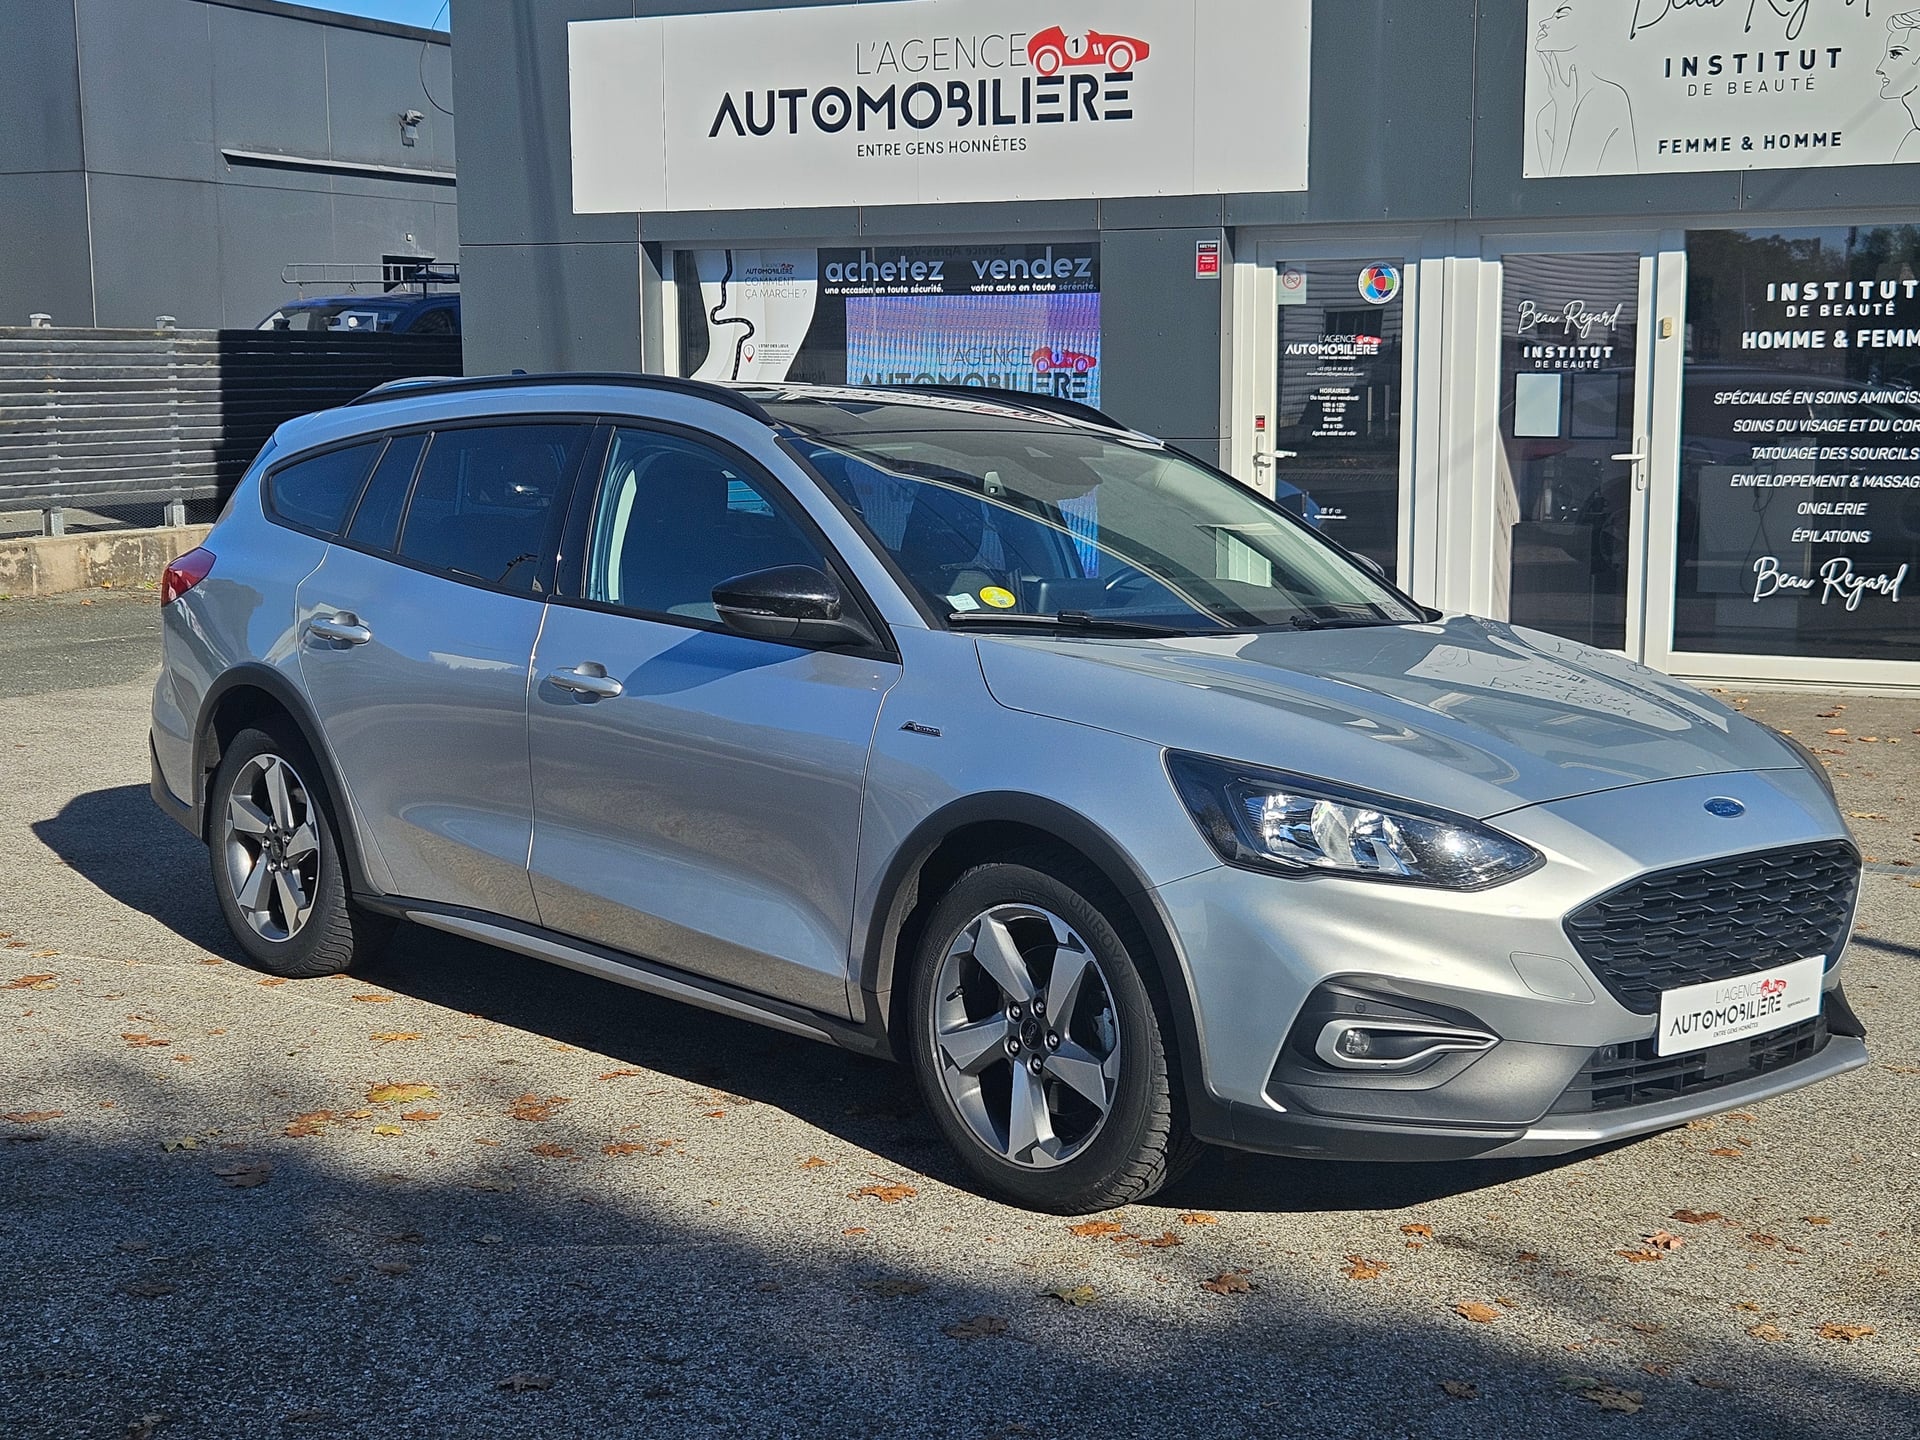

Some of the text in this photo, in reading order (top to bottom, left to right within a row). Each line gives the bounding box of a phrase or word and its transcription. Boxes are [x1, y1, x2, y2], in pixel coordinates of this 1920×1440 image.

[855, 33, 1027, 75] L'AGENCE
[1664, 47, 1843, 78] INSTITUT
[1687, 74, 1817, 97] DE BEAUTÉ
[708, 71, 1134, 138] AUTOMOBILIERE
[857, 135, 1027, 158] ENTRE GENS HONNÊTES
[1658, 131, 1842, 155] FEMME & HOMME
[825, 250, 945, 283] achetez
[971, 246, 1093, 280] vendez
[745, 276, 796, 287] COMMENT
[825, 286, 839, 294] une
[841, 285, 874, 294] occasion
[887, 285, 909, 294] toute
[910, 283, 944, 293] sécurité.
[971, 284, 993, 292] votre
[996, 284, 1017, 292] auto
[1031, 283, 1056, 291] toute
[1058, 280, 1097, 291] sérénité.
[745, 288, 808, 300] ÇA MARCHE ?
[1766, 280, 1919, 302] INSTITUT
[1786, 300, 1896, 318] DE BEAUTÉ
[1517, 300, 1622, 339] Beau Regard
[1318, 335, 1356, 344] L'AGENCE
[1742, 330, 1826, 349] HOMME
[1833, 330, 1849, 348] &
[937, 347, 1031, 367] L'AGENCE
[1285, 343, 1378, 355] AUTOMOBILIERE
[1523, 346, 1614, 358] INSTITUT
[1535, 359, 1600, 369] DE BEAUTÉ
[1713, 389, 1920, 405] SPÉCIALISÉ EN SOINS AMINCIS
[1733, 419, 1775, 432] SOINS
[1776, 419, 1798, 432] DU
[1800, 419, 1850, 432] VISAGE
[1849, 419, 1869, 432] ET
[1869, 419, 1891, 432] DU
[1751, 447, 1920, 460] TATOUAGE DES SOURCILS
[1730, 474, 1849, 488] ENVELOPPEMENT
[1849, 474, 1859, 488] &
[1797, 502, 1869, 515] ONGLERIE
[1791, 527, 1872, 543] ÉPILATIONS
[1752, 556, 1909, 611] Beau Regard
[1715, 980, 1763, 1004] L'AGENCE
[1669, 993, 1782, 1037] AUTOMOBILIERE
